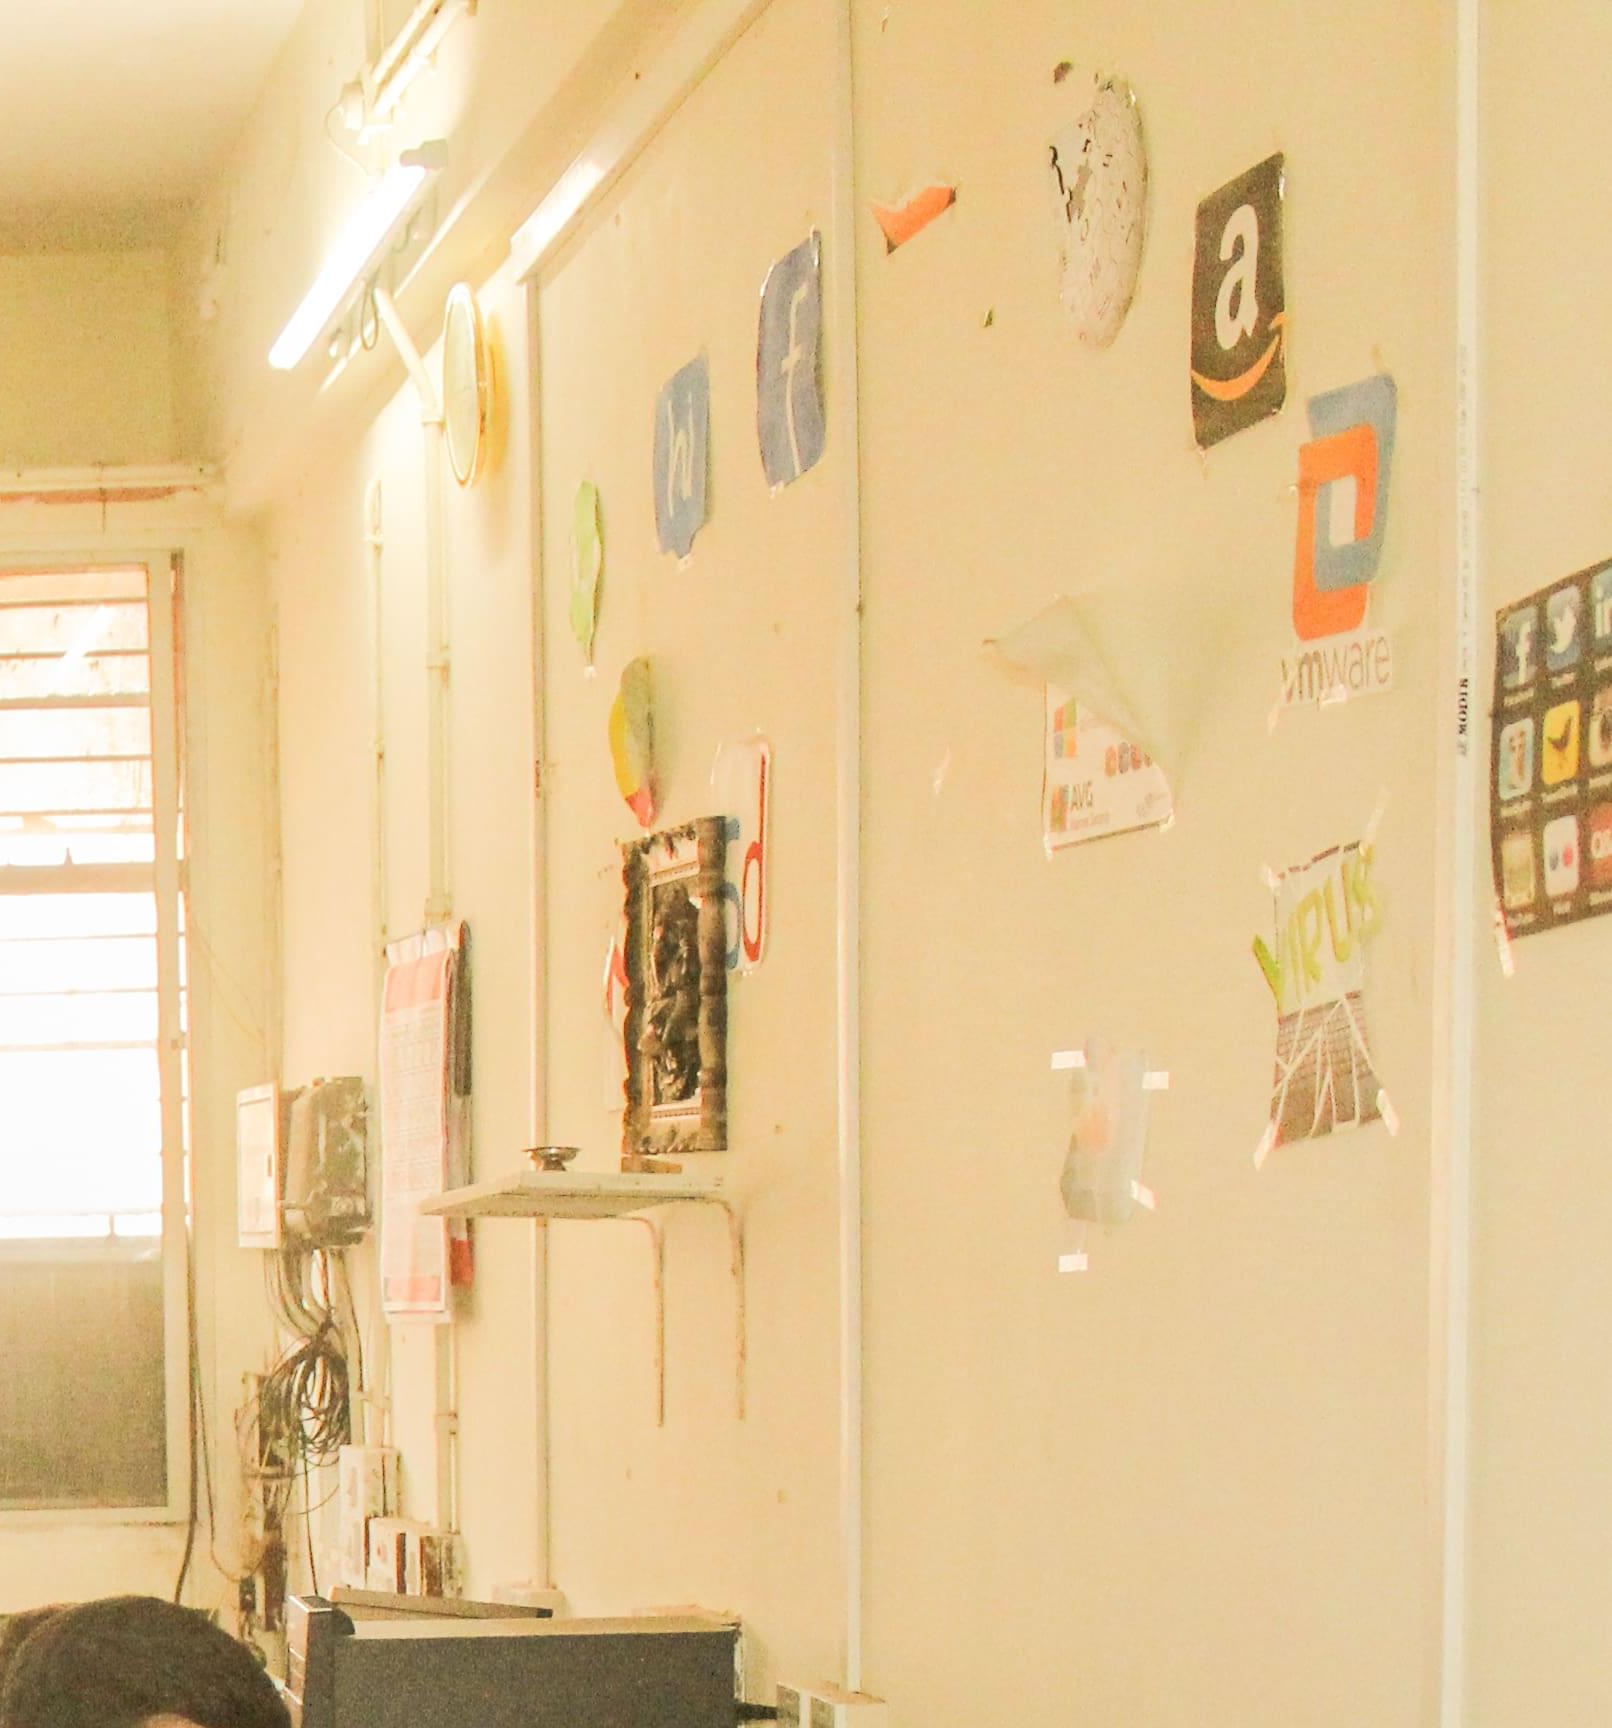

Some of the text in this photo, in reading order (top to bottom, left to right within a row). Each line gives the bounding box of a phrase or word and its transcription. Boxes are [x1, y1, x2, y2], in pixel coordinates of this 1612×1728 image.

[1215, 204, 1259, 350] a
[1281, 636, 1391, 705] vmware
[1253, 845, 1382, 1012] VIRUS
